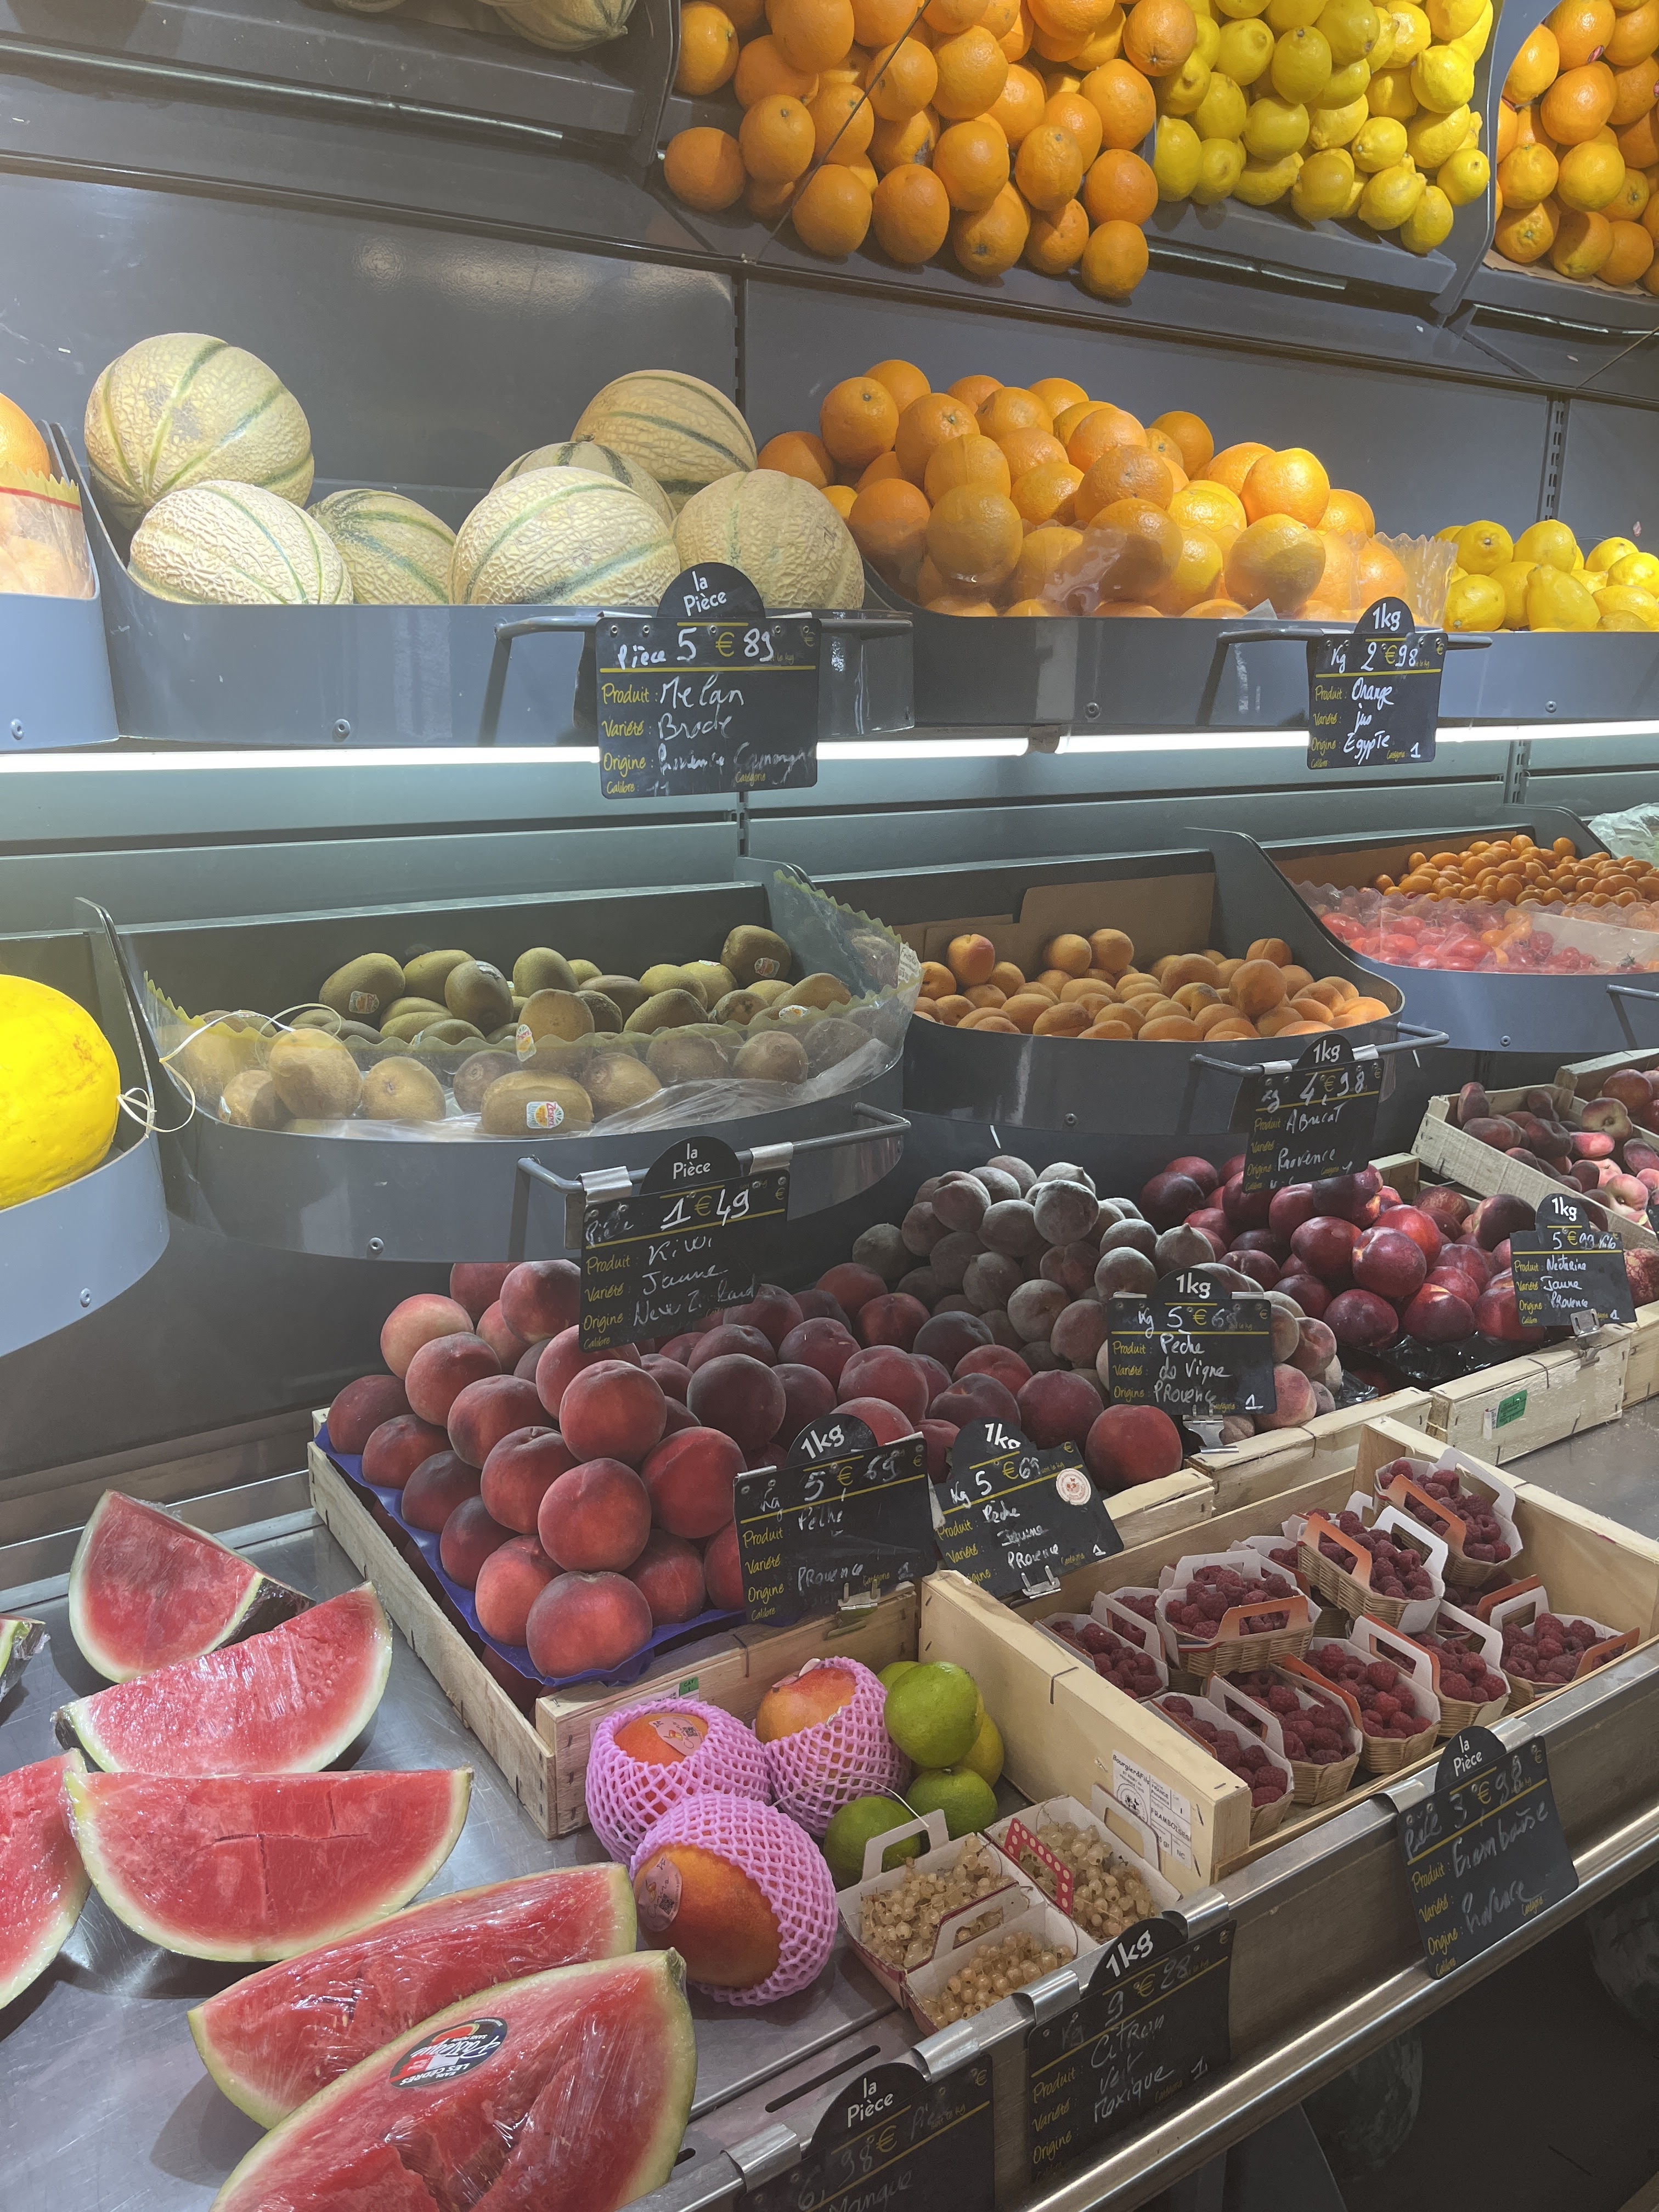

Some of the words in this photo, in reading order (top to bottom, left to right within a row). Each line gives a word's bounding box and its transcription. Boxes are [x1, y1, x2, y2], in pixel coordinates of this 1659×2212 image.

[691, 571, 708, 591] la
[683, 590, 727, 617] Pièce
[1373, 603, 1401, 631] 1kg
[676, 627, 697, 661] 5
[715, 631, 735, 657] €
[743, 627, 774, 662] 89
[1361, 642, 1377, 672] 2
[1385, 644, 1397, 664] €
[1395, 645, 1418, 667] 98
[1313, 1040, 1341, 1063] 1kg
[1323, 1075, 1336, 1092] €
[686, 1143, 698, 1160] la
[673, 1159, 711, 1180] Pièce
[660, 1197, 691, 1230] 1
[694, 1195, 712, 1216] €
[715, 1188, 749, 1226] 49
[775, 1187, 785, 1200] €
[1551, 1197, 1577, 1222] 1kg
[1553, 1232, 1562, 1250] 5
[1567, 1231, 1578, 1245] €
[1176, 1272, 1211, 1299] 1kg
[1167, 1306, 1183, 1328] 5
[1192, 1308, 1207, 1325] €
[800, 1424, 845, 1459] 1kg
[804, 1471, 826, 1502] 5
[837, 1465, 853, 1487] €
[975, 1470, 992, 1496] 5
[1002, 1461, 1018, 1480] €
[1458, 1735, 1470, 1754] la
[1453, 1751, 1482, 1777] Pièce
[1152, 1784, 1169, 1799] FRANCE
[1449, 1793, 1467, 1829] 3
[1477, 1780, 1493, 1805] €
[1151, 1808, 1190, 1842] FRAMBOISES
[1105, 1929, 1153, 1977] 1kg
[1137, 1973, 1155, 1998] €
[447, 2063, 470, 2072] LES
[862, 2077, 877, 2098] la
[847, 2091, 894, 2128] Pièce
[875, 2124, 898, 2153] €
[975, 2069, 988, 2086] €
